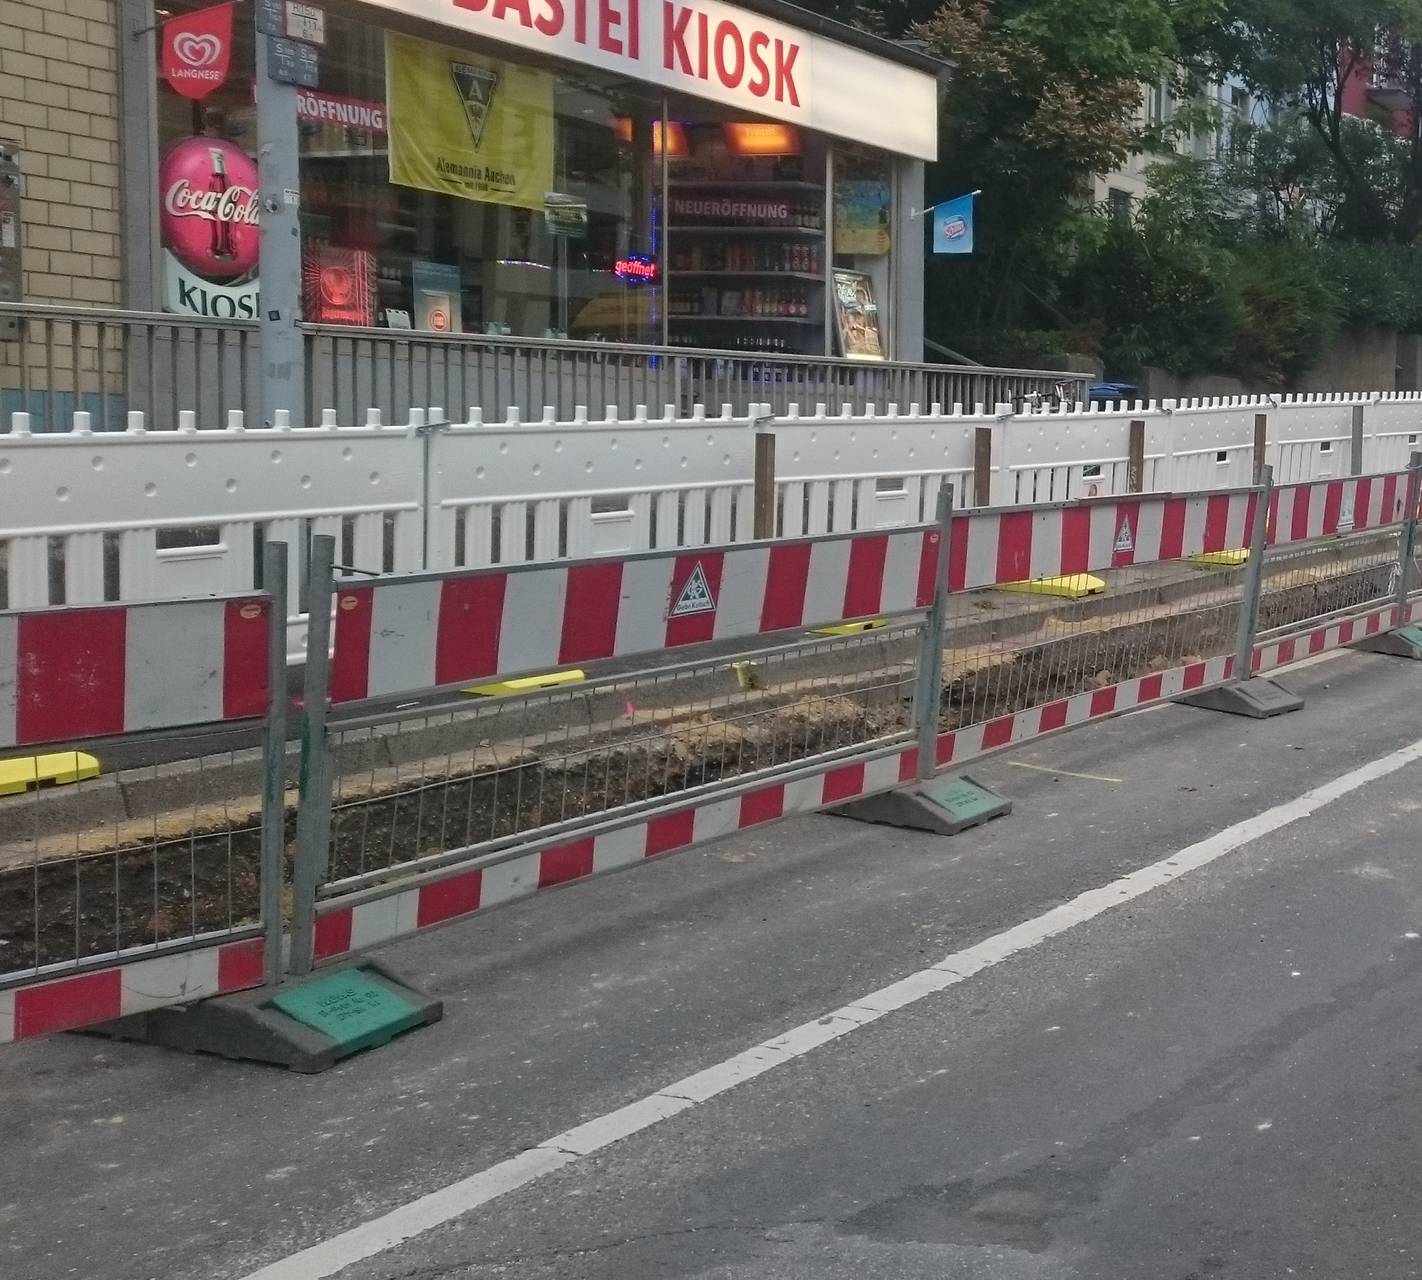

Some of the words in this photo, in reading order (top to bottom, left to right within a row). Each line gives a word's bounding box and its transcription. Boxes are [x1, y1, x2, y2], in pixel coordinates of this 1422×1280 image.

[663, 1, 801, 107] KIOSK
[171, 67, 219, 80] LANGNESE
[468, 79, 483, 101] A
[435, 157, 482, 180] Alemannia
[484, 166, 516, 186] Aachen
[674, 199, 788, 219] NEUERÖFFNUNG
[615, 260, 655, 277] geöffnet
[178, 277, 260, 319] KIOS
